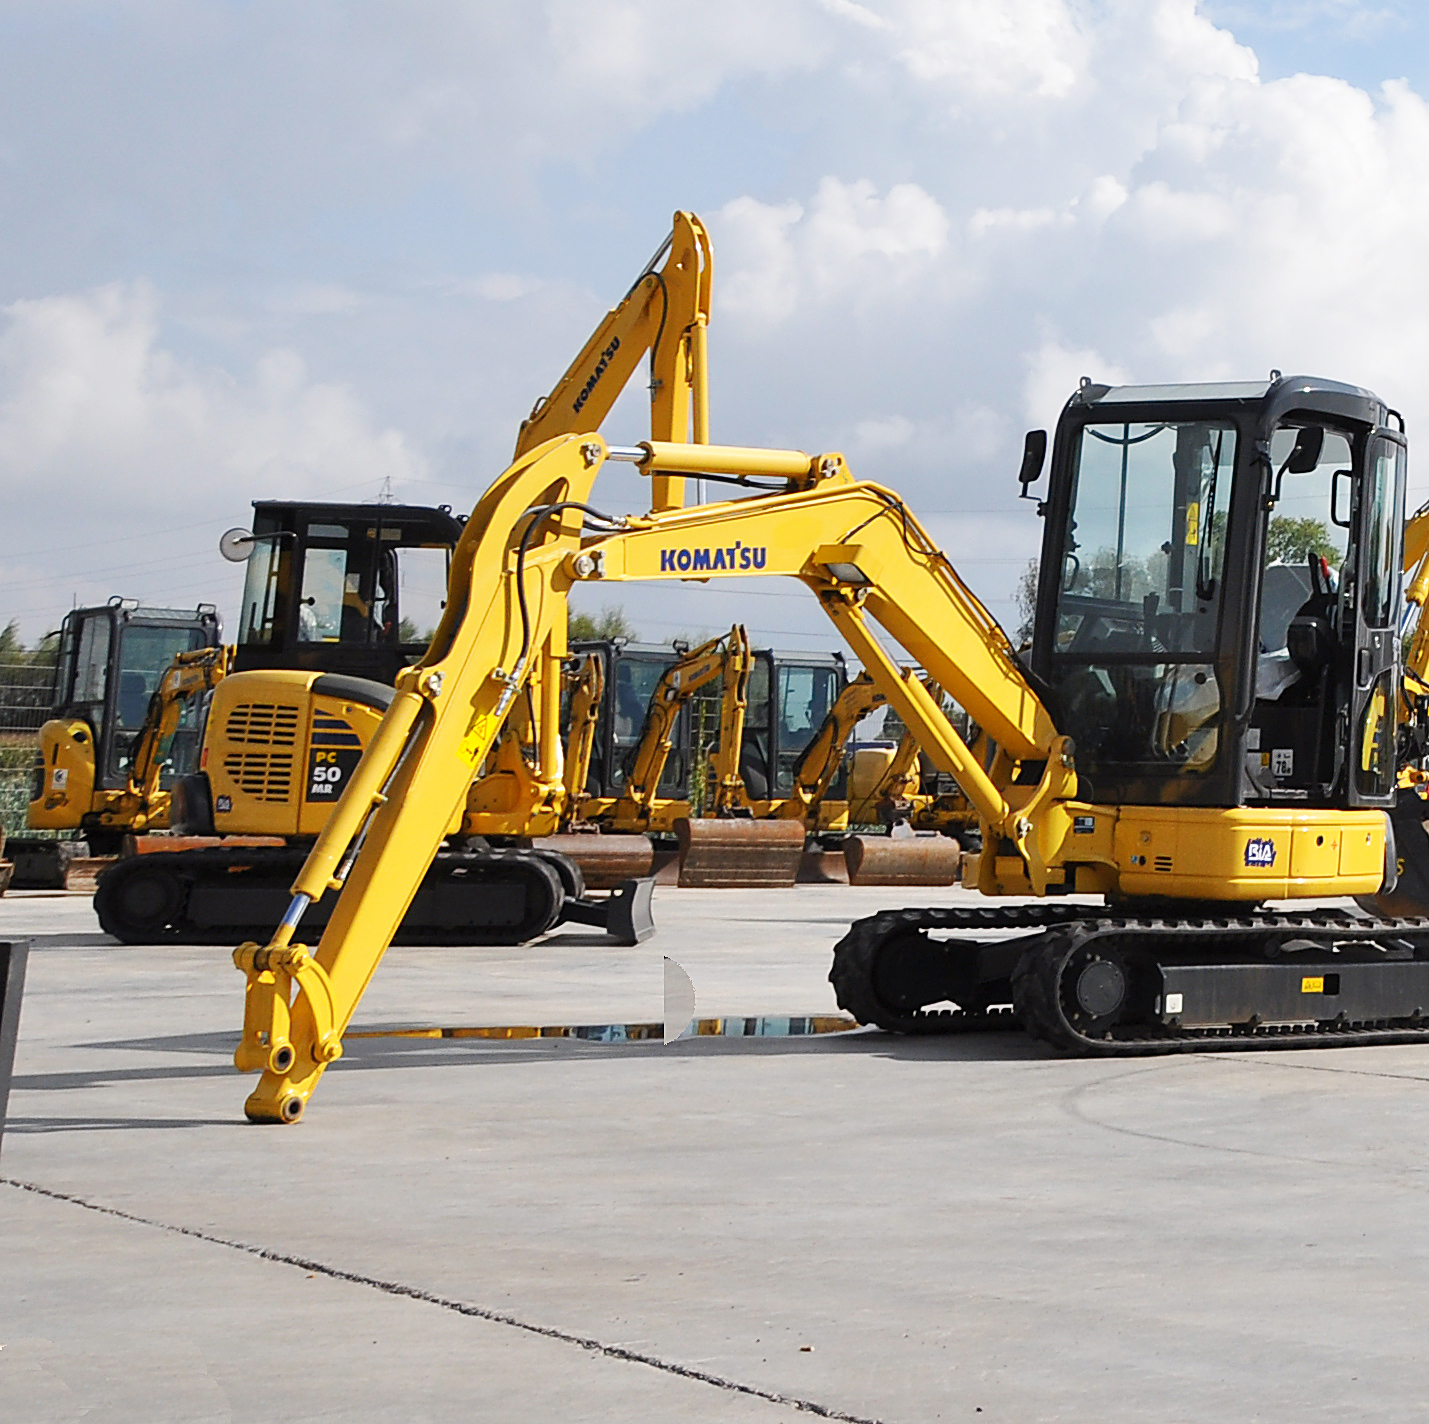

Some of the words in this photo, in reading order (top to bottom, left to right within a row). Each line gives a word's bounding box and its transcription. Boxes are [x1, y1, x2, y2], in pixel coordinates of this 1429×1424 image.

[573, 336, 621, 413] KOMATSU
[661, 541, 767, 572] KOMATSU
[316, 752, 337, 763] PC
[313, 766, 342, 782] 50
[311, 783, 333, 794] MR
